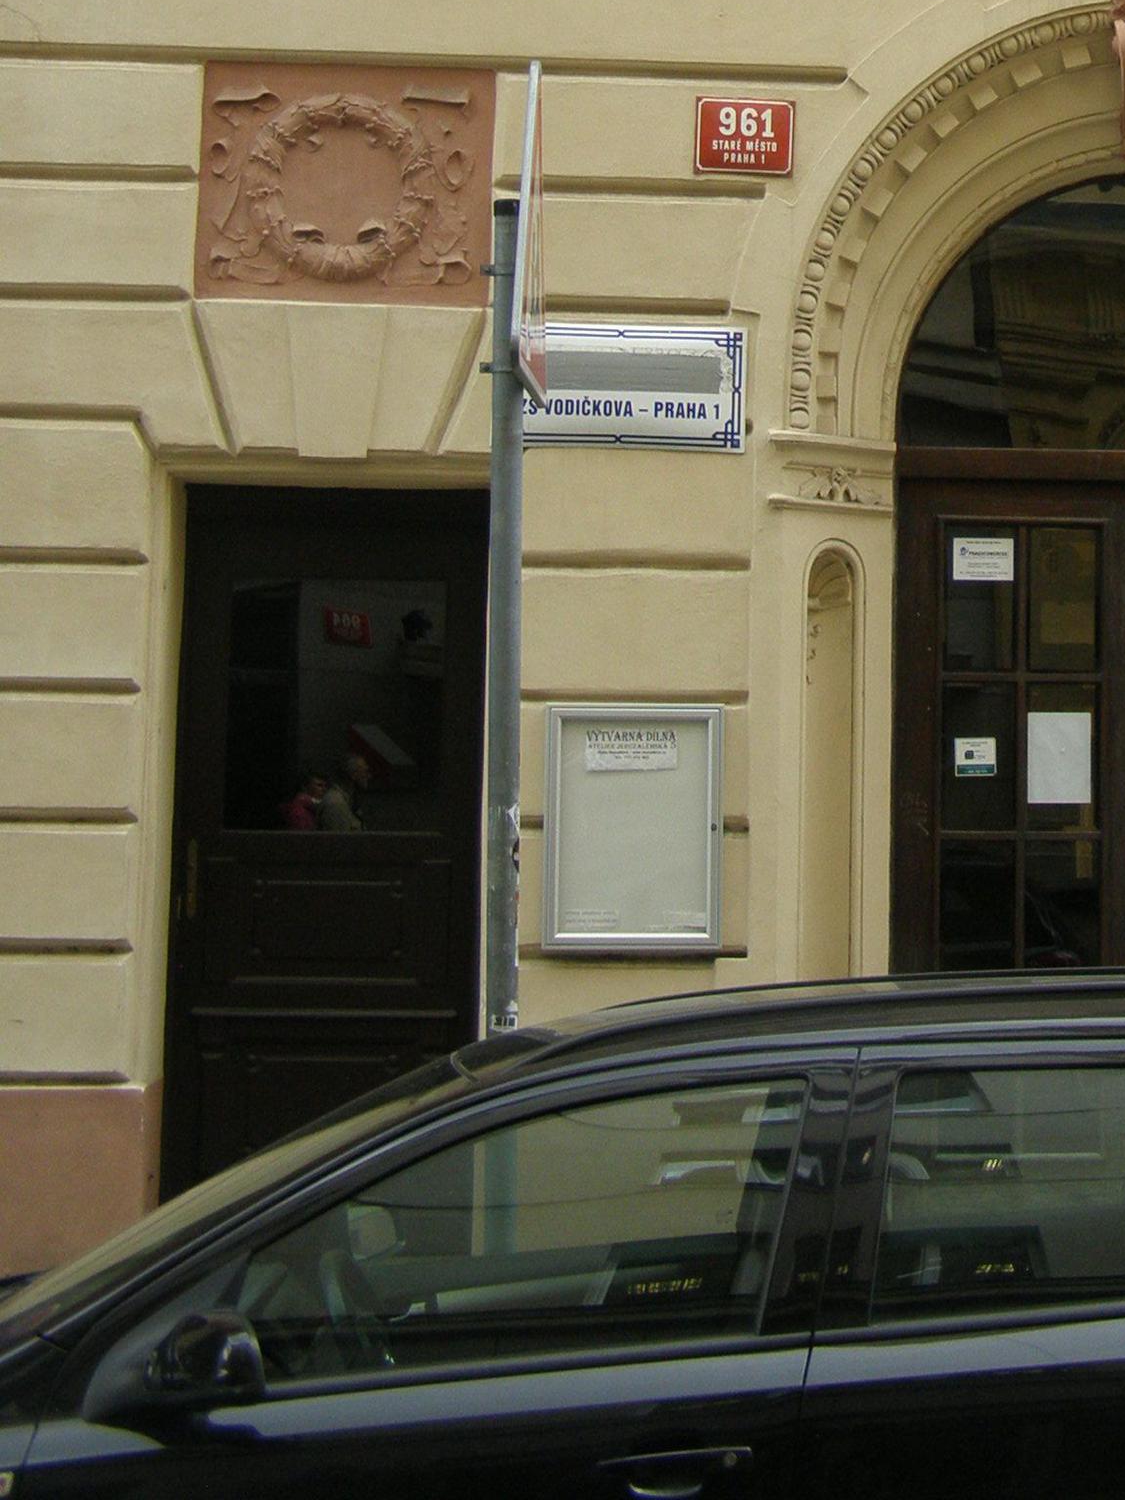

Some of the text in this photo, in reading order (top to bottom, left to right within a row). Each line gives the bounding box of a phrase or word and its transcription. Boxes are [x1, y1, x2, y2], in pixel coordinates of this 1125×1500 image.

[718, 106, 775, 138] 961
[723, 152, 766, 165] PRAHA 1
[545, 395, 634, 418] VODIČKOVA
[654, 401, 707, 420] PRAHA
[713, 403, 720, 420] 1
